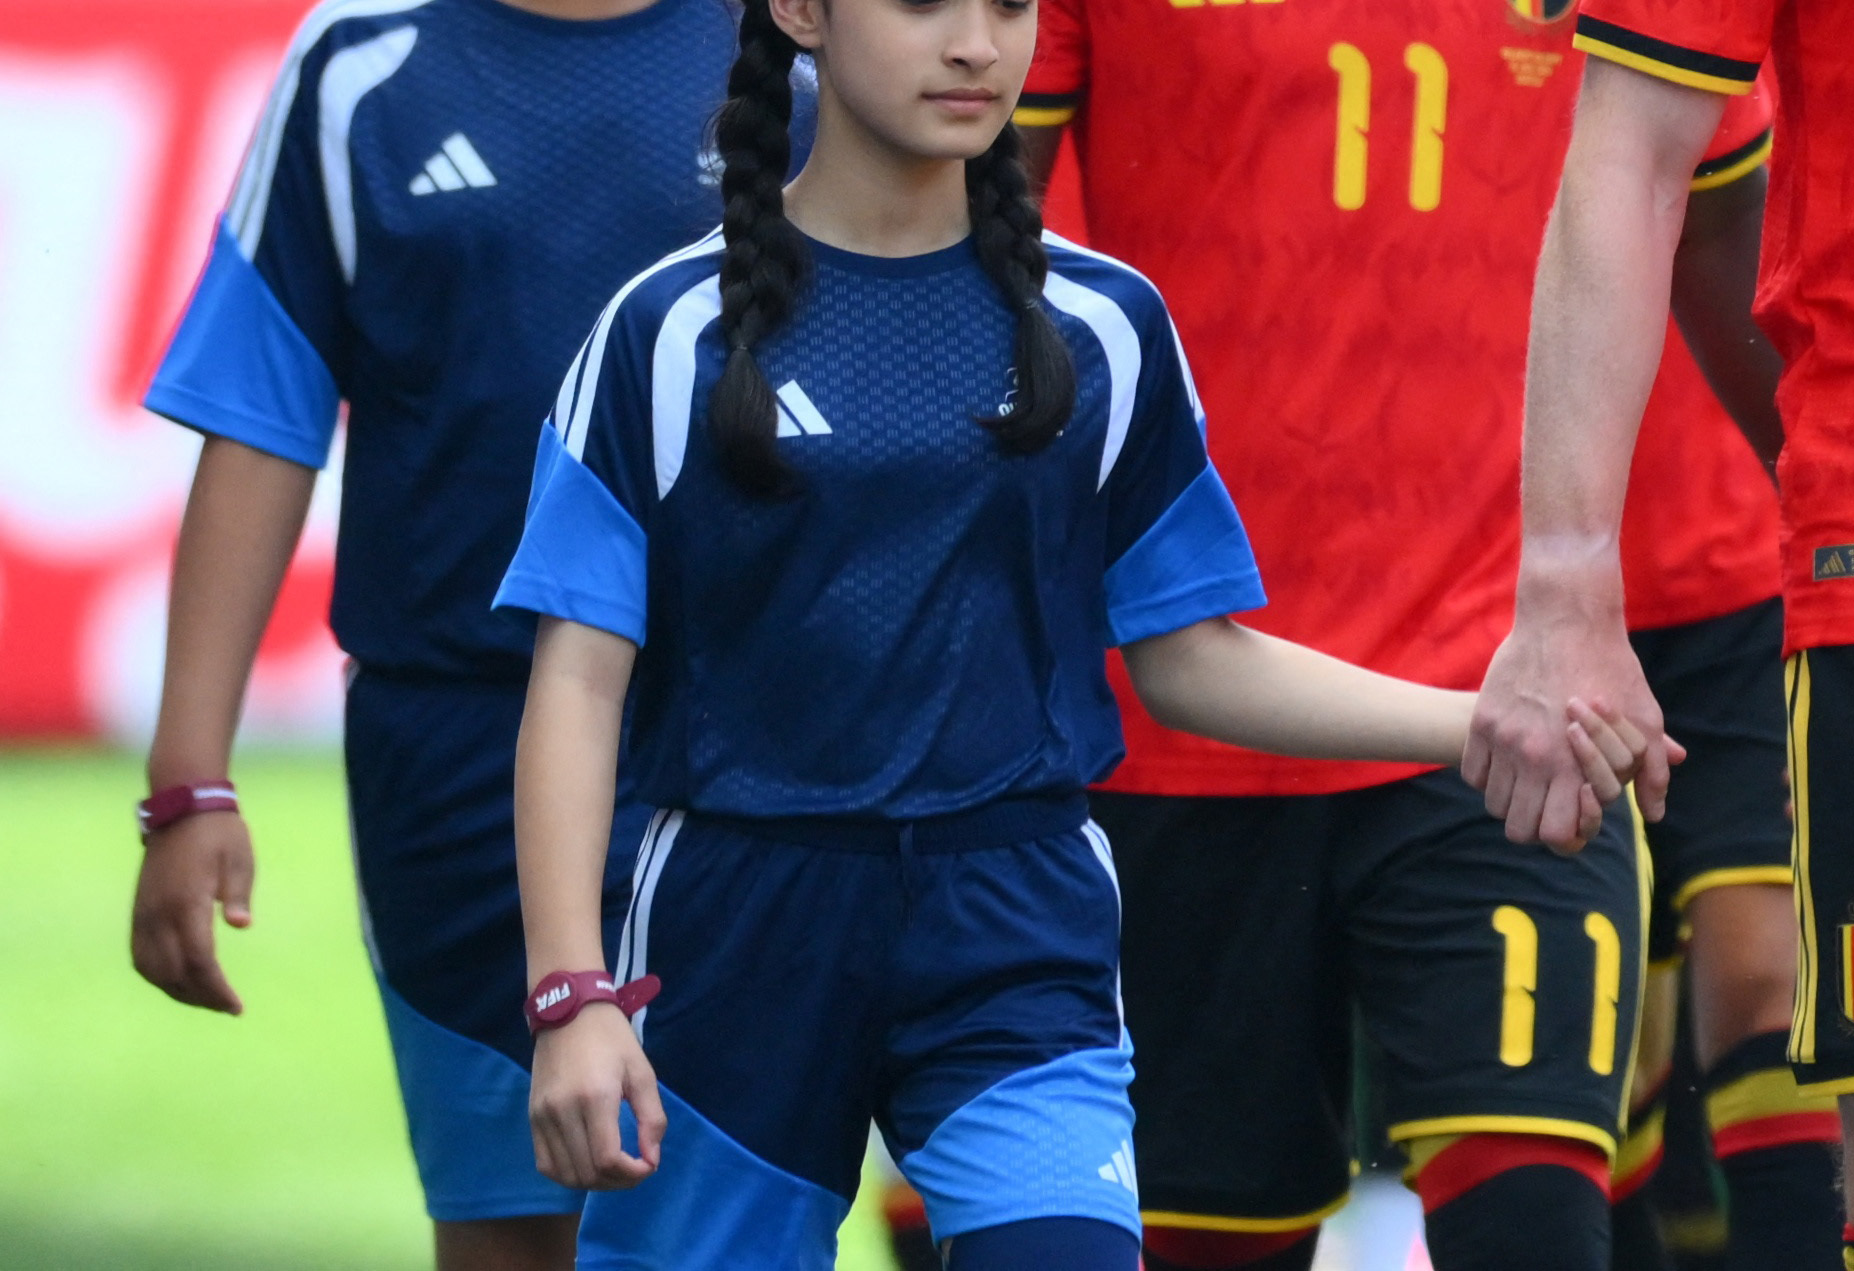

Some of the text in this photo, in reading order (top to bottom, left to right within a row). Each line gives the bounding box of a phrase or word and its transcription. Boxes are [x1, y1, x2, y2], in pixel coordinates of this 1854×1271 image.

[1328, 41, 1449, 212] 11
[535, 982, 571, 1012] FIFA
[1491, 905, 1621, 1075] 11
